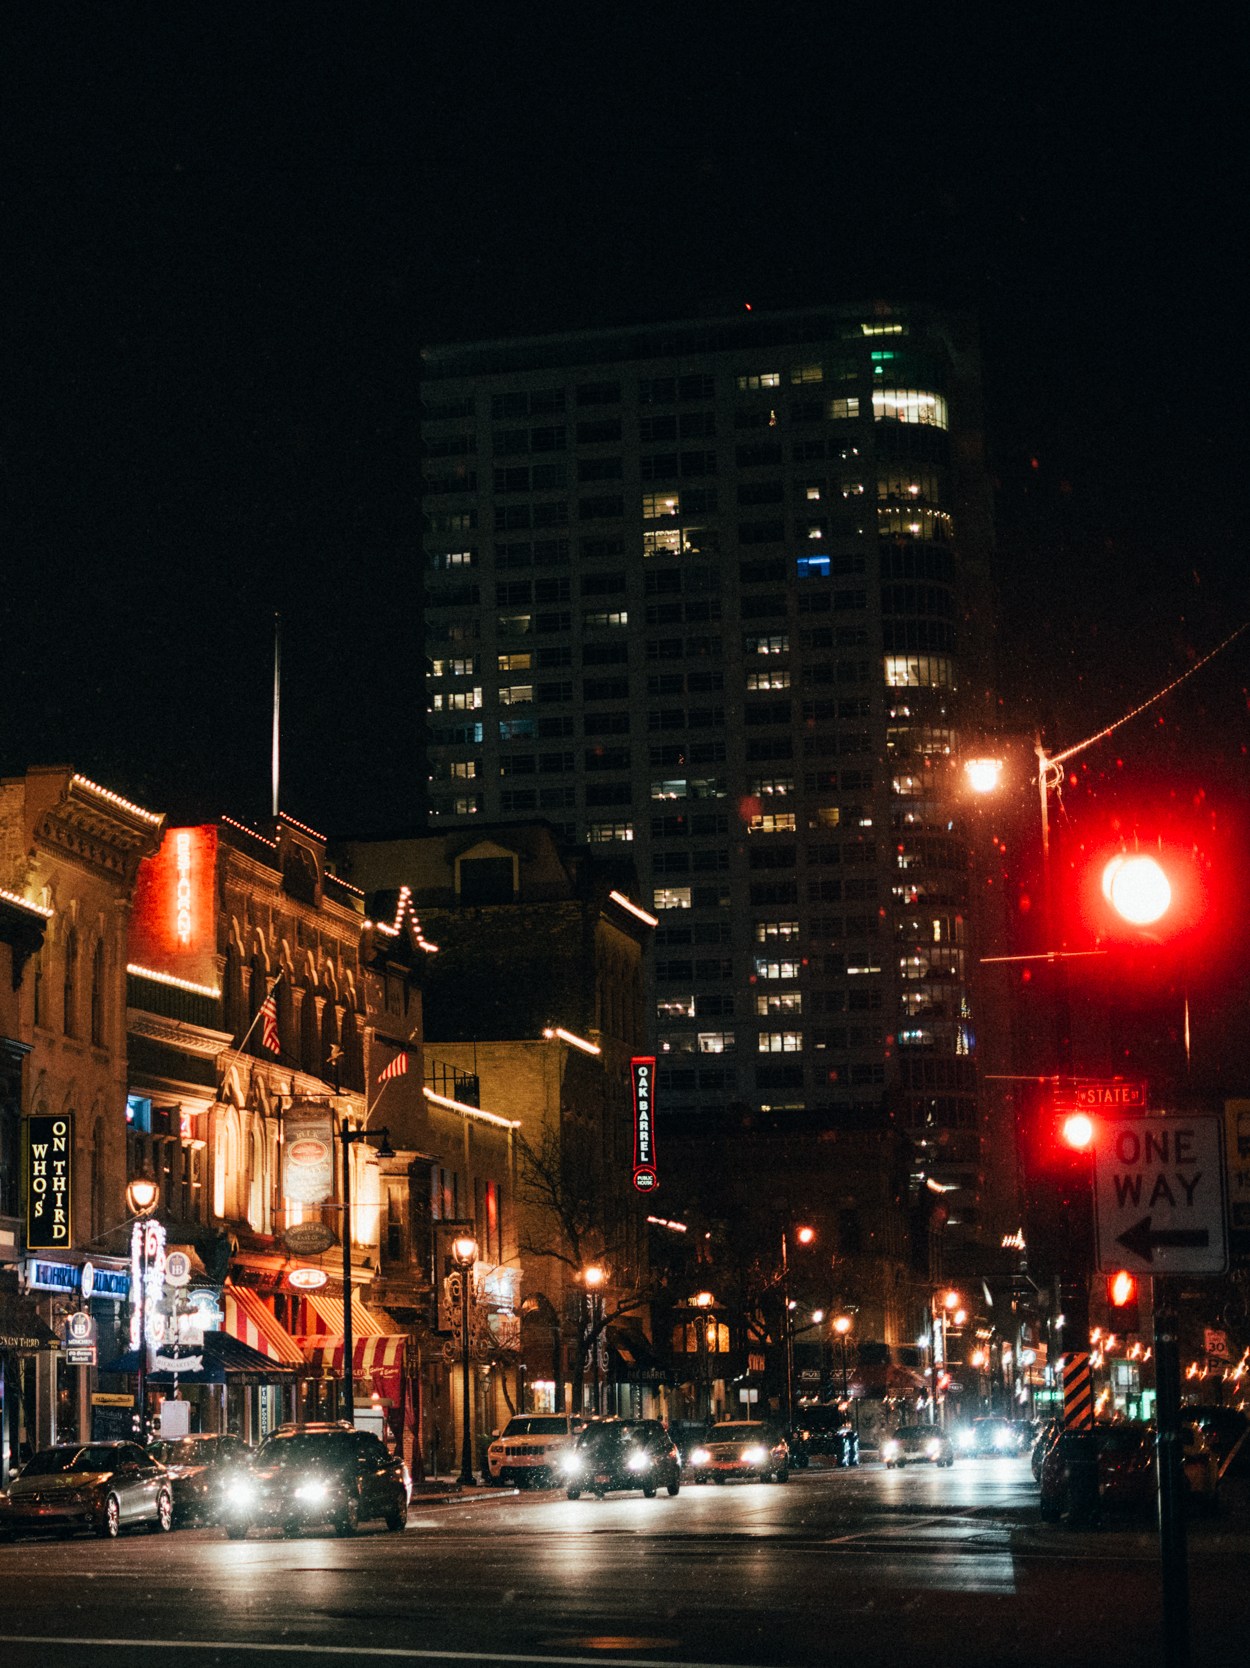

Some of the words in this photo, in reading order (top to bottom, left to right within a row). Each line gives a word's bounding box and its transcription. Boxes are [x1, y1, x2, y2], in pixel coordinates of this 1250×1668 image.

[637, 1066, 648, 1098] OAK
[1087, 1089, 1131, 1104] STATE
[52, 1120, 67, 1153] ON
[639, 1100, 649, 1162] BARREL
[1115, 1130, 1197, 1165] ONE
[31, 1144, 49, 1218] WHO'S
[1114, 1172, 1202, 1209] WAY
[52, 1160, 67, 1240] THIRD
[293, 1272, 324, 1285] OPEN
[156, 1357, 197, 1370] BIERGARTEN
[1208, 1342, 1225, 1352] 30
